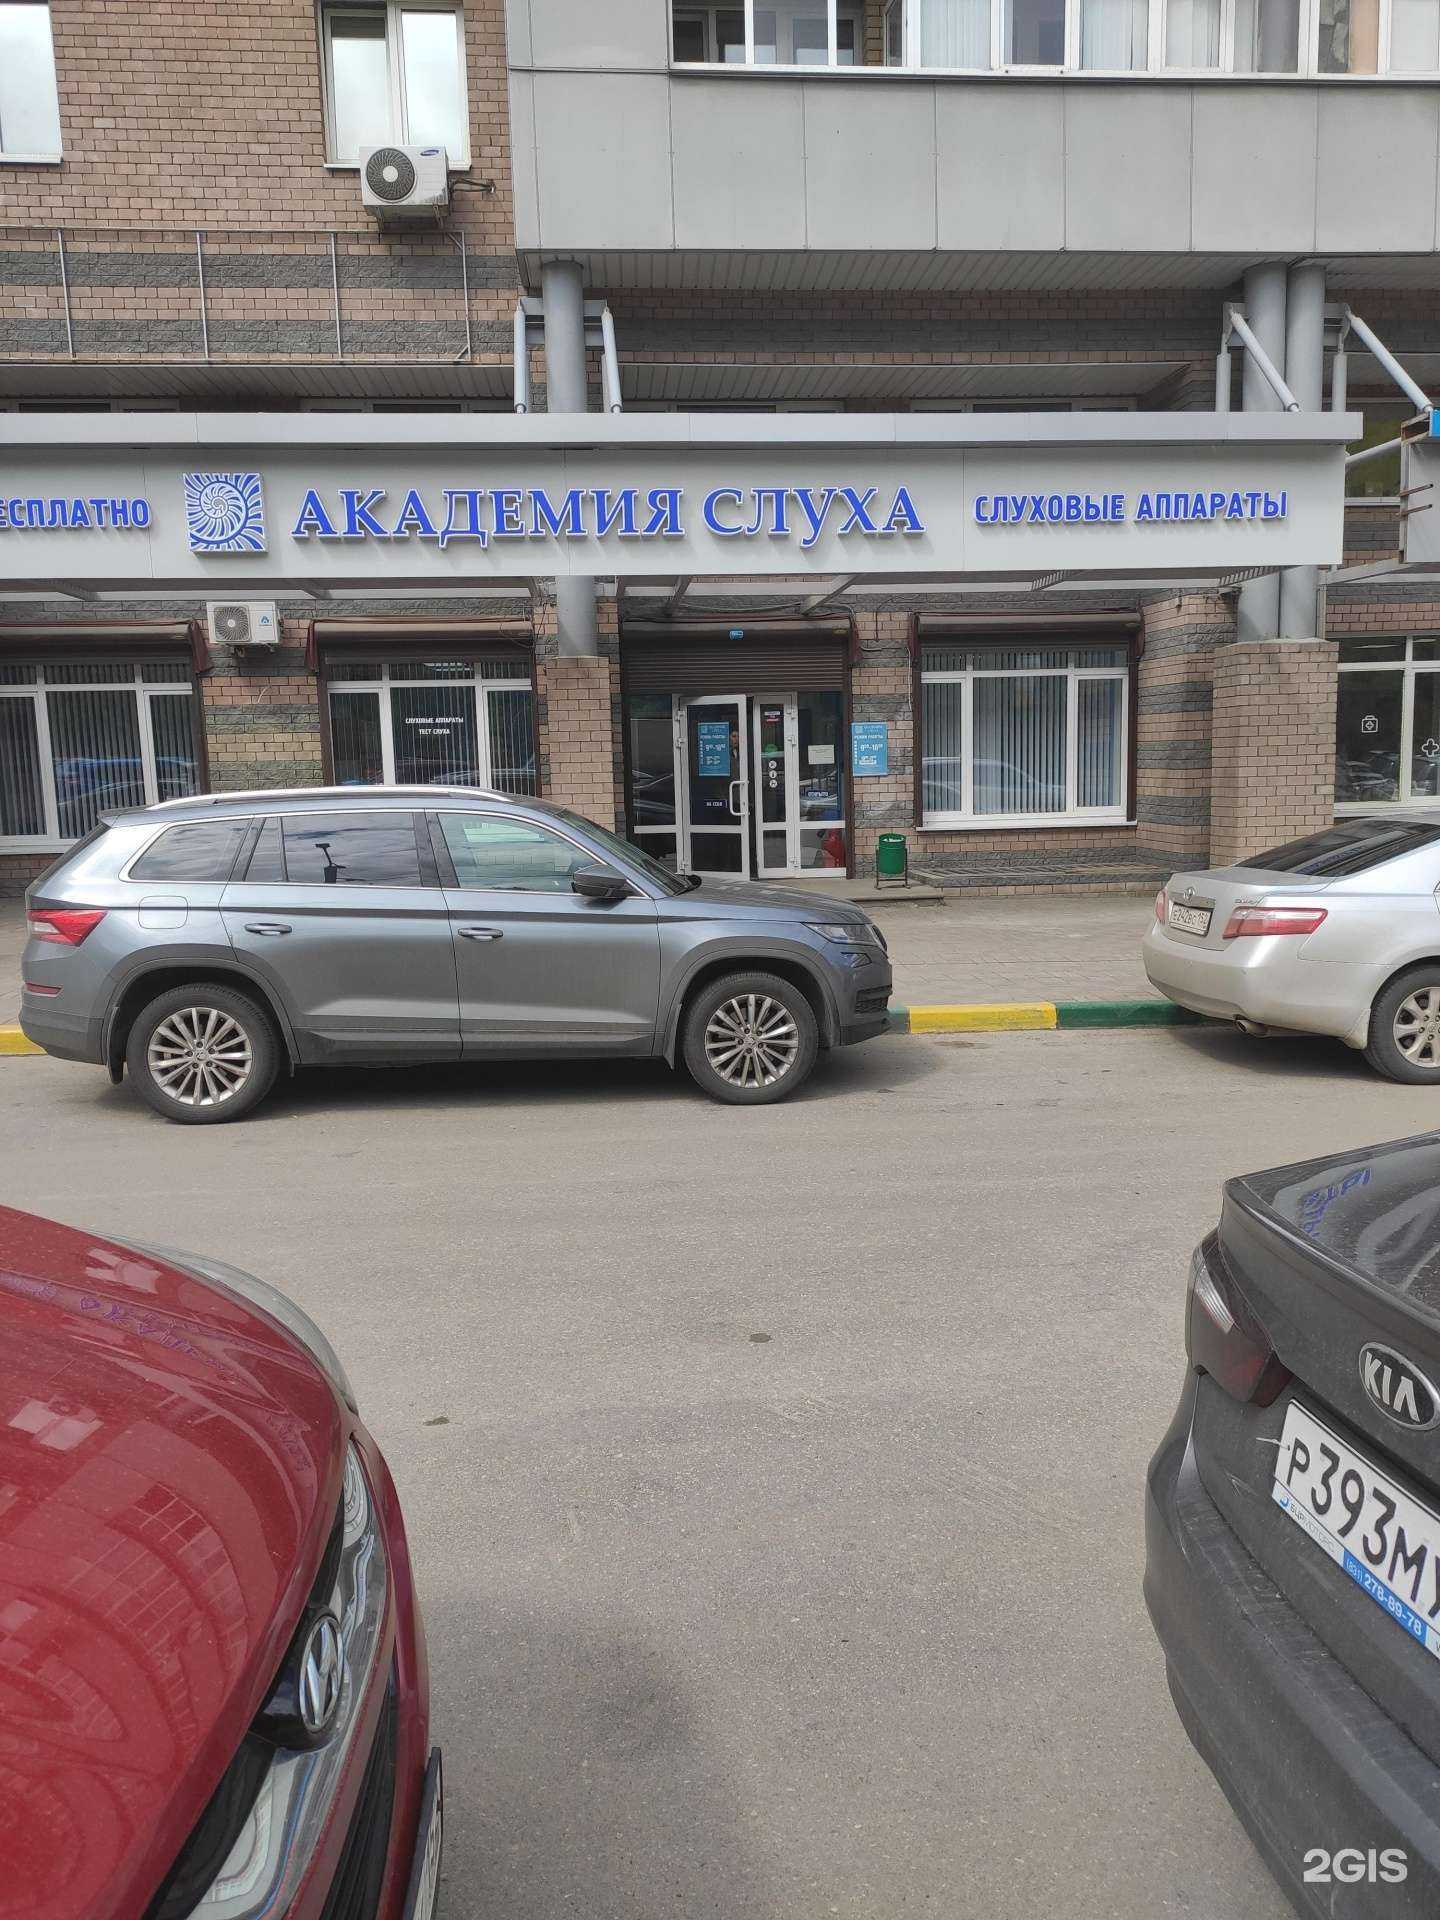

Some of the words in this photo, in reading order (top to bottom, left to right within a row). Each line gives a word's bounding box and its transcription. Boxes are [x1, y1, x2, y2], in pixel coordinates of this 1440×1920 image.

[291, 488, 685, 548] АКАДЕМИЯ
[703, 486, 926, 548] СЛУХА
[974, 493, 1126, 523] СЛУХОВЫЕ
[1136, 491, 1288, 521] АППАРАТЫ
[1364, 1351, 1421, 1423] KIA
[1364, 1573, 1423, 1636] 278-89-78
